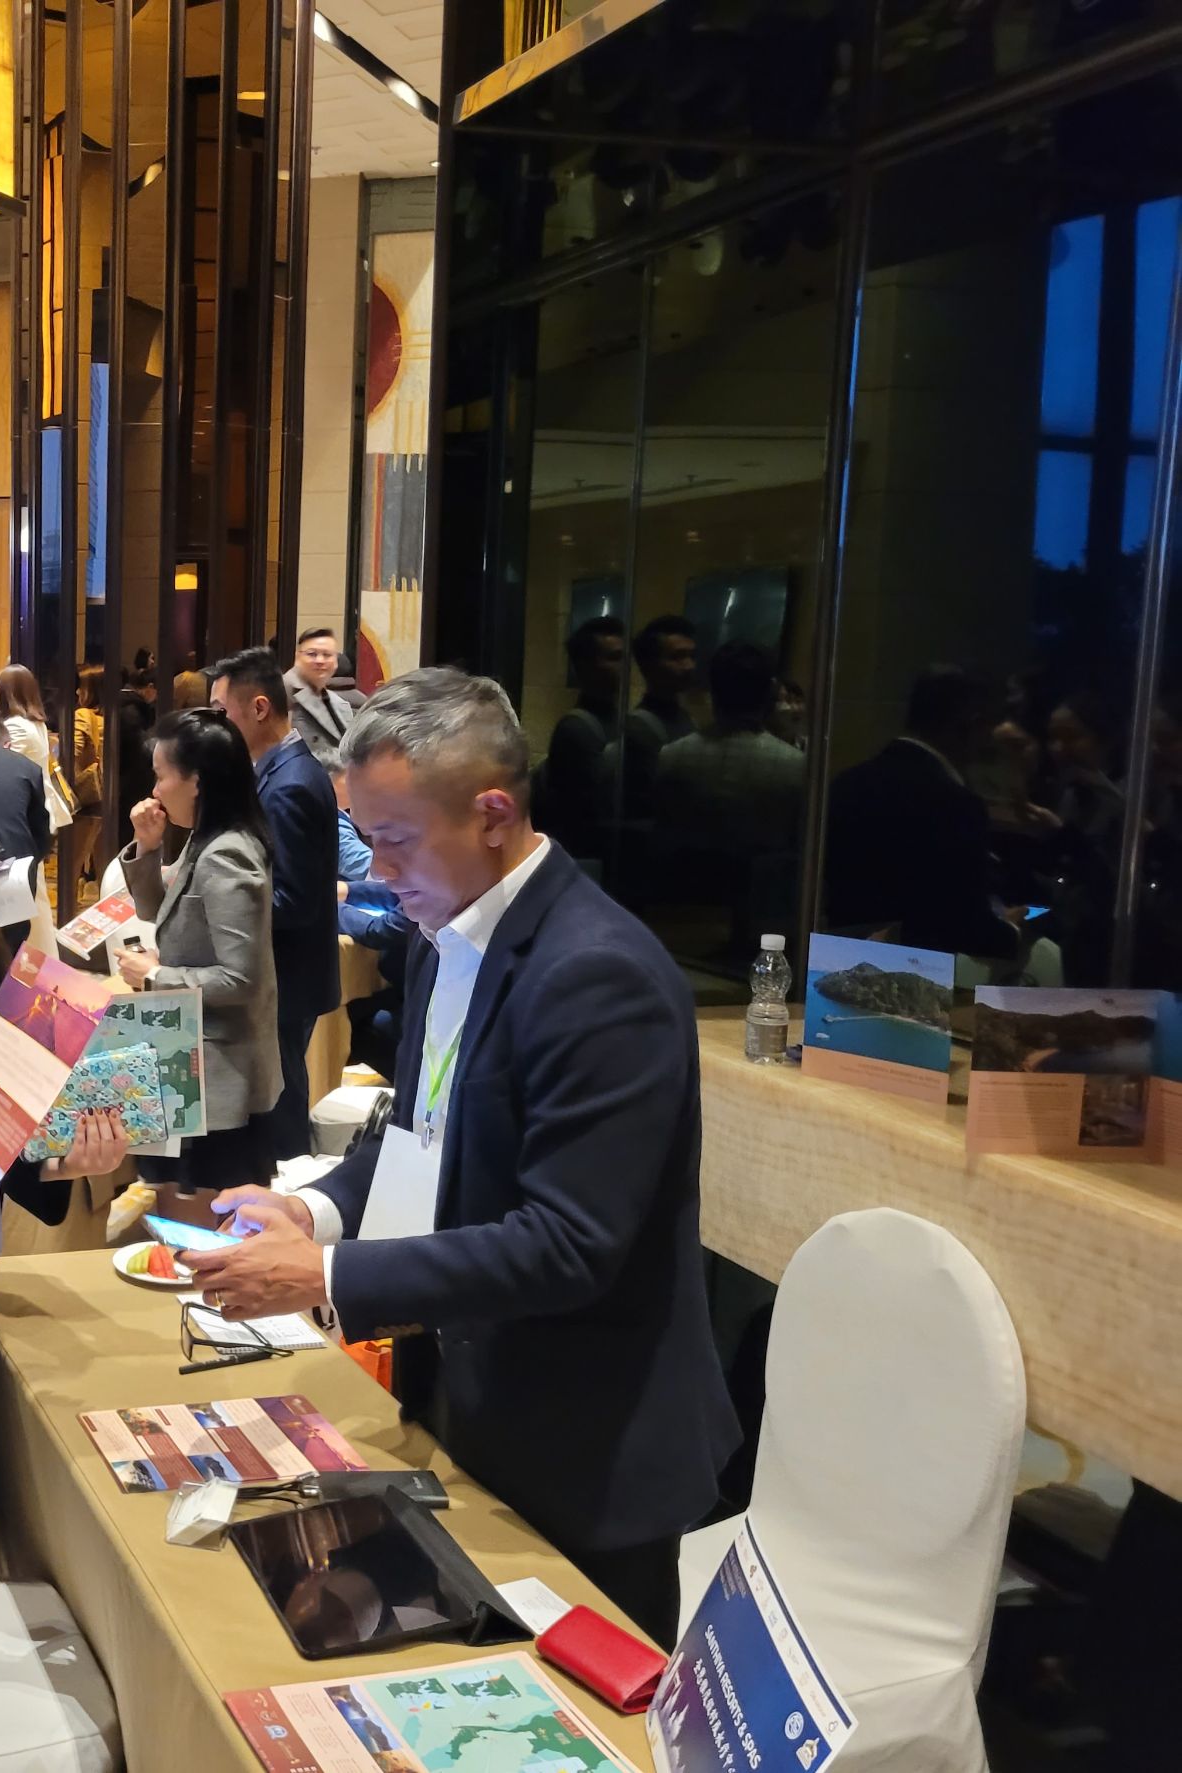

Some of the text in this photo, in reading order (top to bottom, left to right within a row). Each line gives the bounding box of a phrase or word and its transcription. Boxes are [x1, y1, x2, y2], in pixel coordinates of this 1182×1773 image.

[719, 1671, 744, 1727] RESORTS
[737, 1722, 748, 1738] &
[741, 1732, 762, 1770] SPAS
